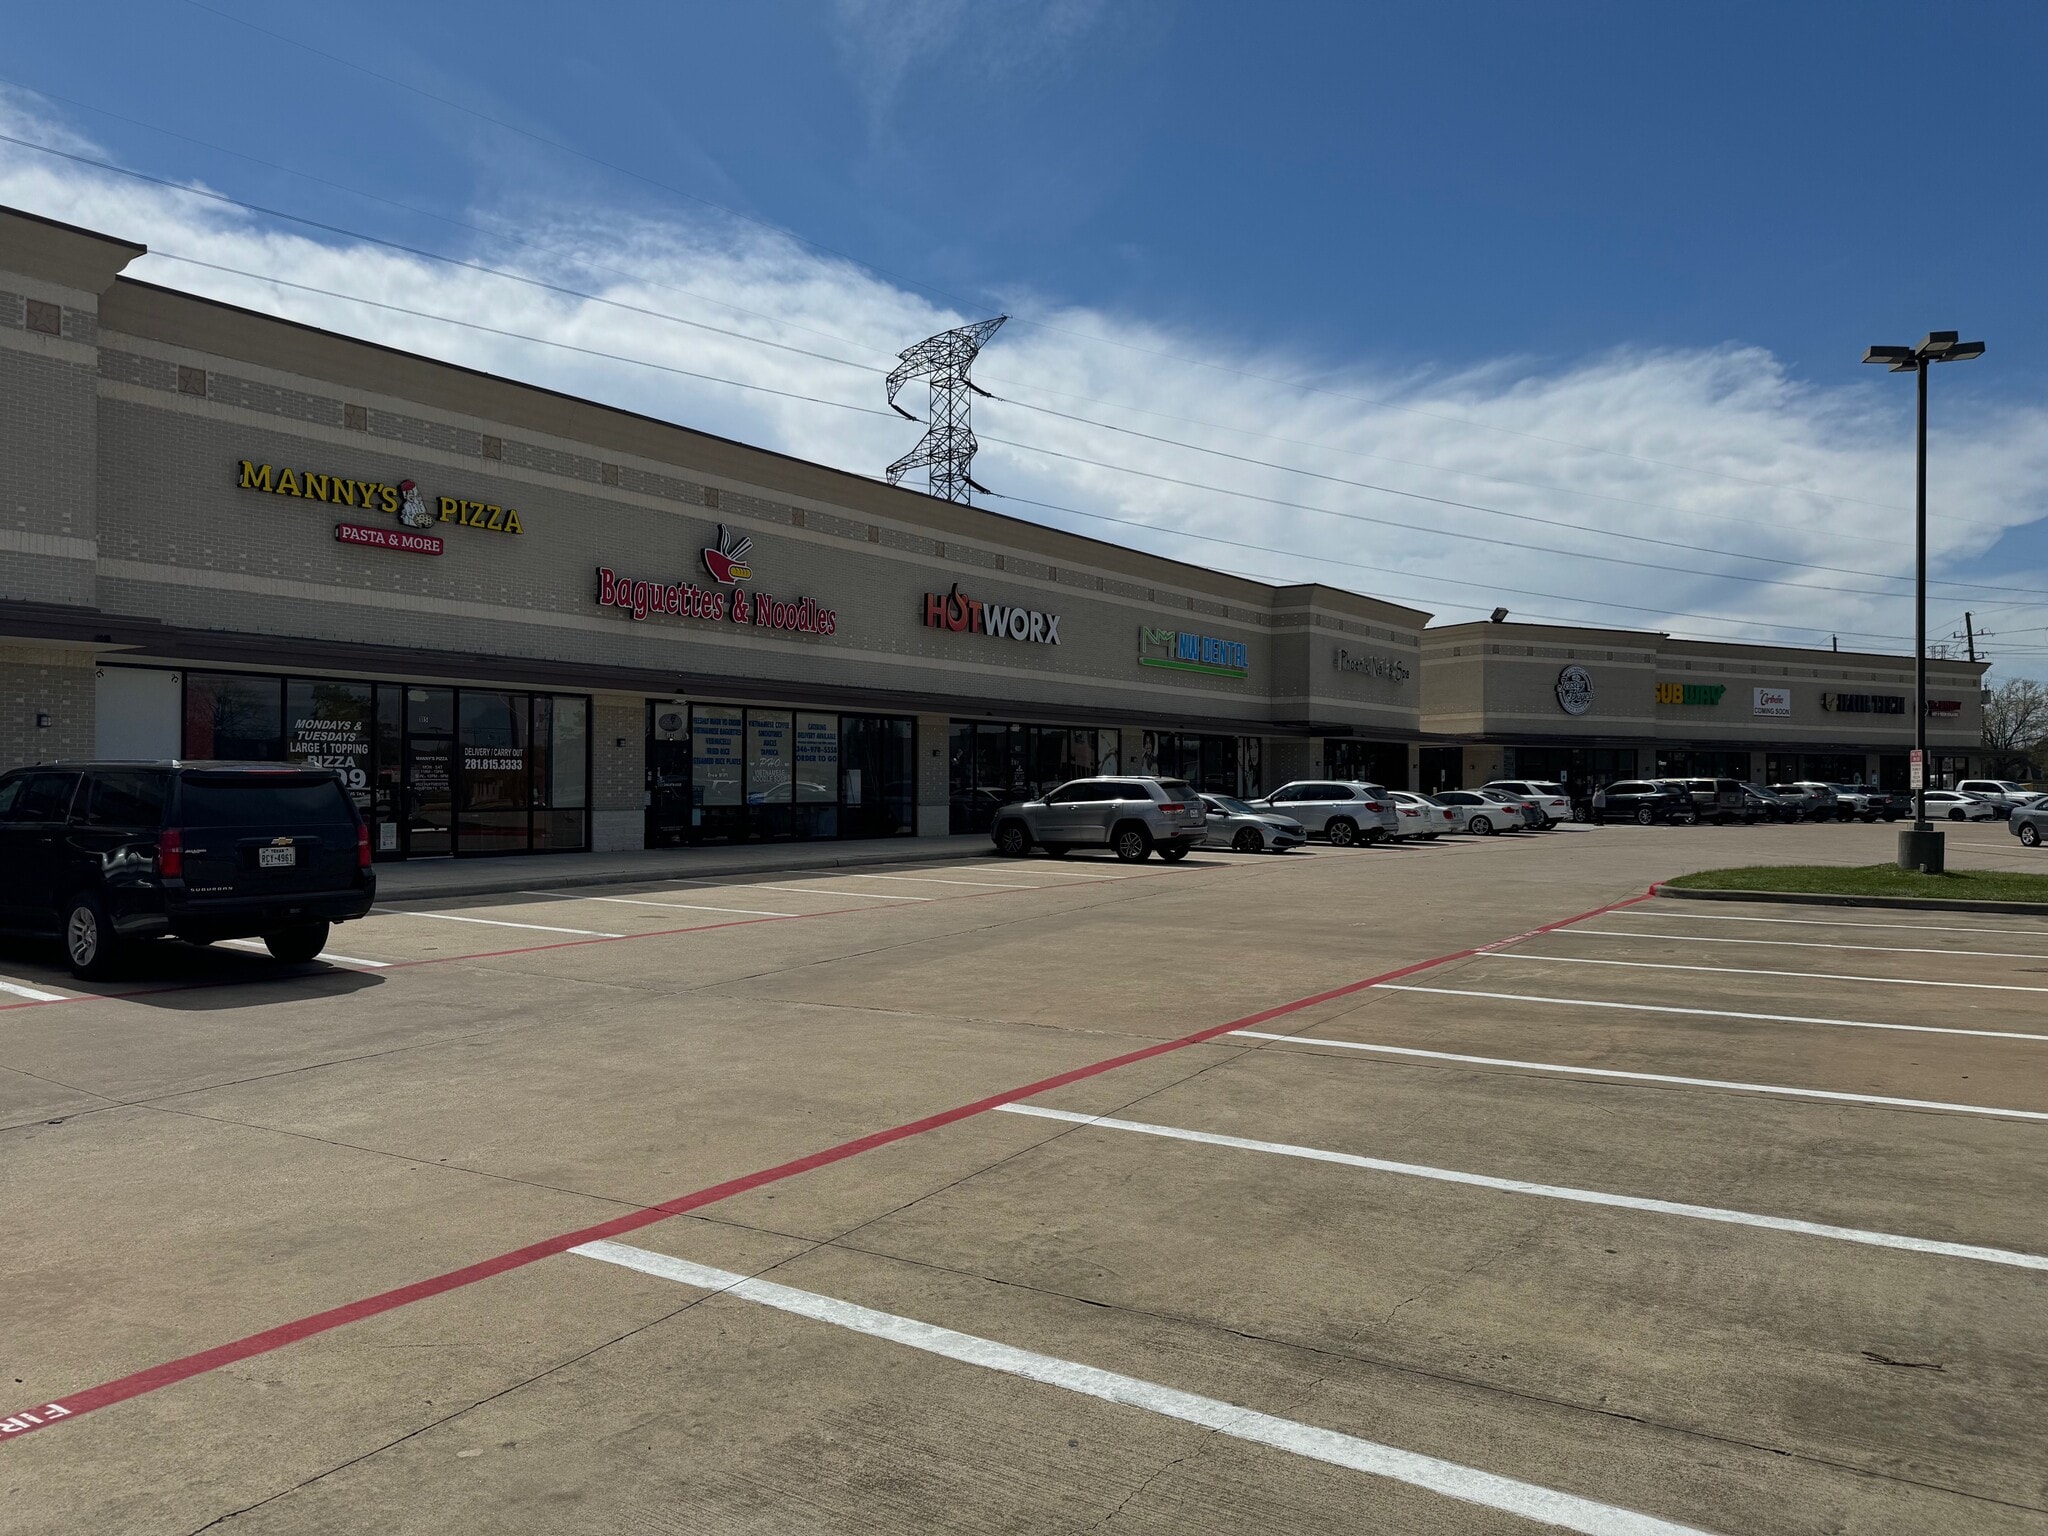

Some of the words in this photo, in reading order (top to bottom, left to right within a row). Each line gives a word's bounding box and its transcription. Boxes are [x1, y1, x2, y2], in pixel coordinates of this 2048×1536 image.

[238, 460, 398, 513] MANNY'S
[437, 496, 524, 534] PIZZA
[342, 526, 386, 545] PASTA
[388, 533, 400, 547] &
[401, 536, 441, 552] MORE
[599, 567, 724, 621] Baguettes
[731, 588, 749, 623] &
[755, 592, 837, 636] Noodles
[924, 583, 1061, 645] HOTWORX
[1178, 632, 1201, 663] NW
[1203, 636, 1249, 669] DENTAL
[1656, 682, 1727, 706] SUBWAY
[294, 719, 352, 731] MONDAYS
[354, 721, 363, 731] &
[298, 731, 356, 742] TUESDAYS
[290, 742, 320, 753] LARGE
[323, 743, 328, 754] 1
[330, 744, 368, 755] TOPPING
[464, 747, 491, 757] DELIVERY
[494, 748, 512, 757] CARRY
[512, 748, 524, 757] OUT
[465, 758, 524, 771] 281.815.3333
[796, 755, 817, 763] ORDER
[827, 755, 838, 763] GO
